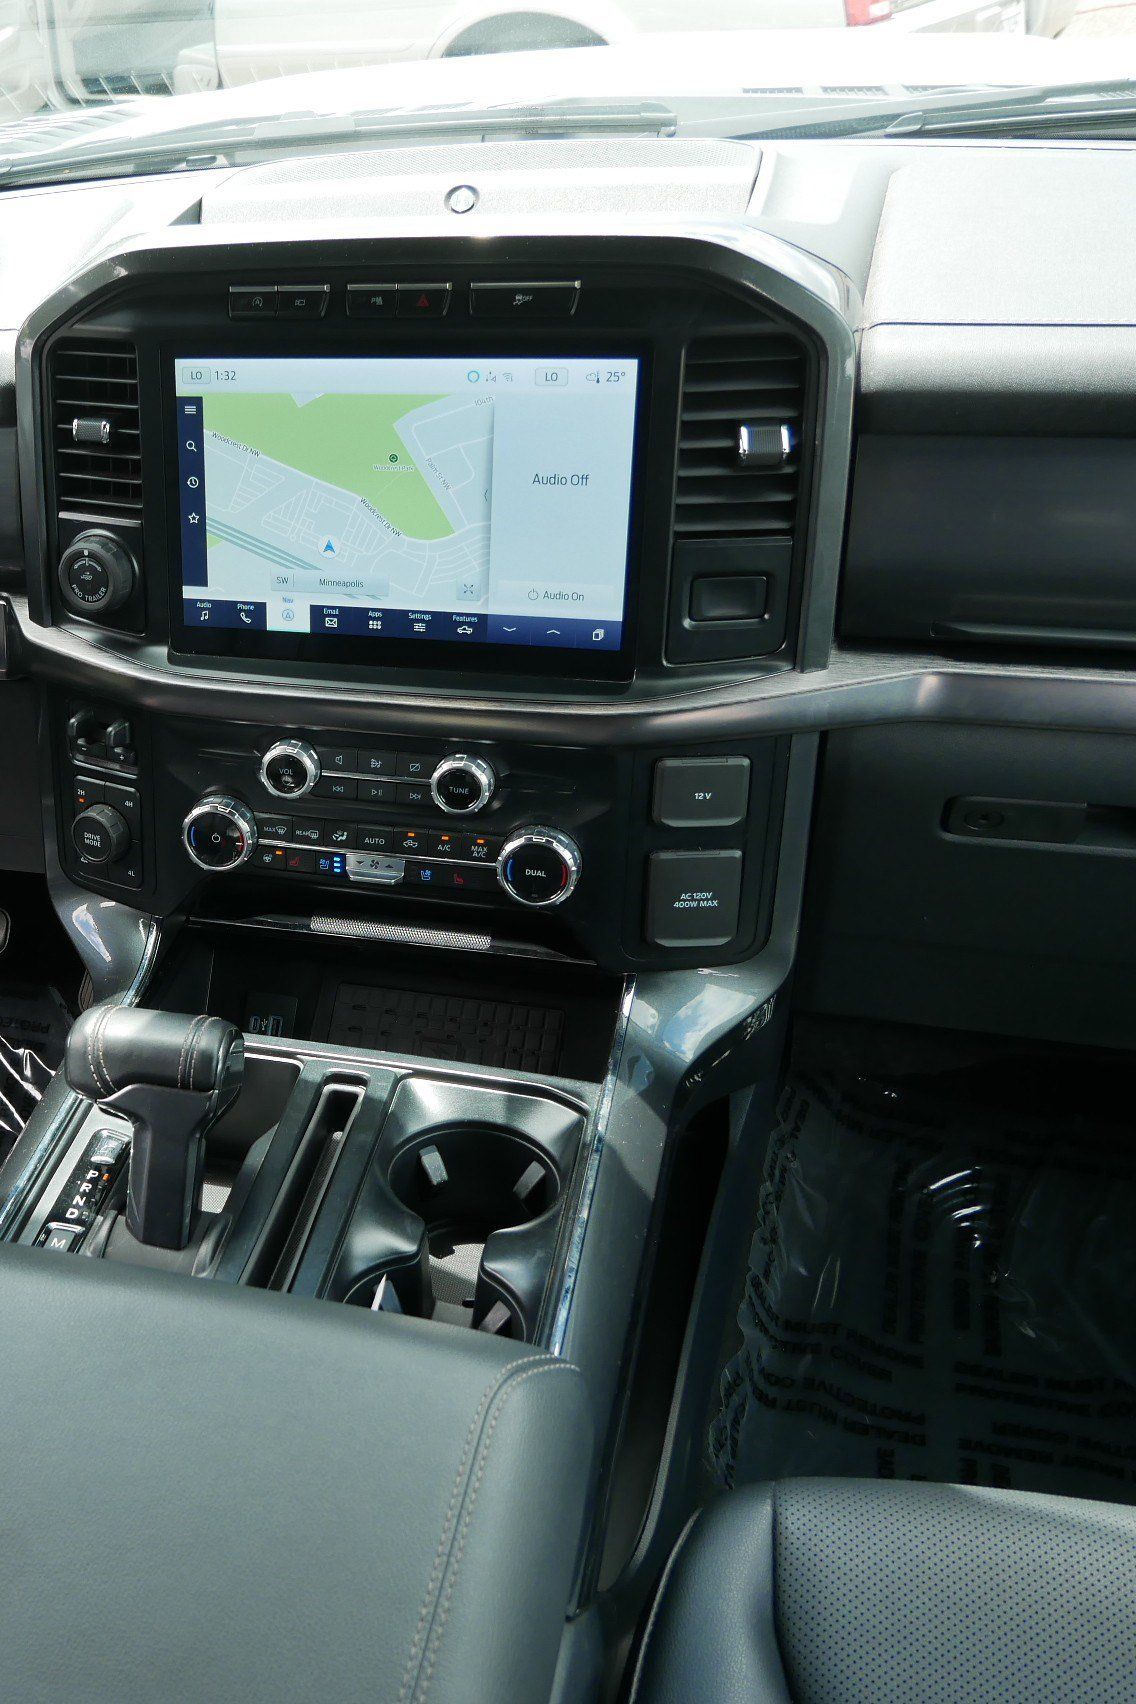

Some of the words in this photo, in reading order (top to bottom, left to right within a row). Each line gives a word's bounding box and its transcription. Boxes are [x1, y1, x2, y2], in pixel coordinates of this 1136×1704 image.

[190, 371, 203, 380] LO
[214, 370, 236, 381] 1:32
[545, 372, 558, 382] LO
[532, 474, 567, 486] Audio
[570, 474, 590, 486] Off
[360, 497, 385, 524] Woodcrest
[390, 526, 402, 537] NW
[276, 576, 289, 585] SW
[319, 578, 364, 589] Minneapolis
[71, 583, 83, 598] PRO
[84, 586, 107, 602] TRAILER
[543, 590, 569, 601] Audio
[571, 592, 585, 601] On
[237, 603, 255, 611] Phone
[368, 610, 383, 618] Apps
[408, 612, 432, 621] Settings
[452, 615, 478, 623] Features
[279, 768, 293, 776] VOL
[449, 786, 469, 795] TUNE
[694, 792, 703, 800] 12
[124, 800, 133, 808] 4H
[84, 832, 101, 841] DRIVE
[364, 837, 385, 845] AUTO
[84, 838, 101, 847] MODE
[437, 844, 451, 852] A/C
[471, 845, 488, 853] MAX
[525, 868, 546, 878] DUAL
[692, 892, 712, 900] 120V
[673, 900, 698, 908] 400W
[699, 899, 718, 907] MAX
[86, 1169, 98, 1180] P
[80, 1182, 92, 1193] R
[73, 1195, 86, 1207] N
[66, 1208, 78, 1219] D
[51, 1237, 66, 1249] M
